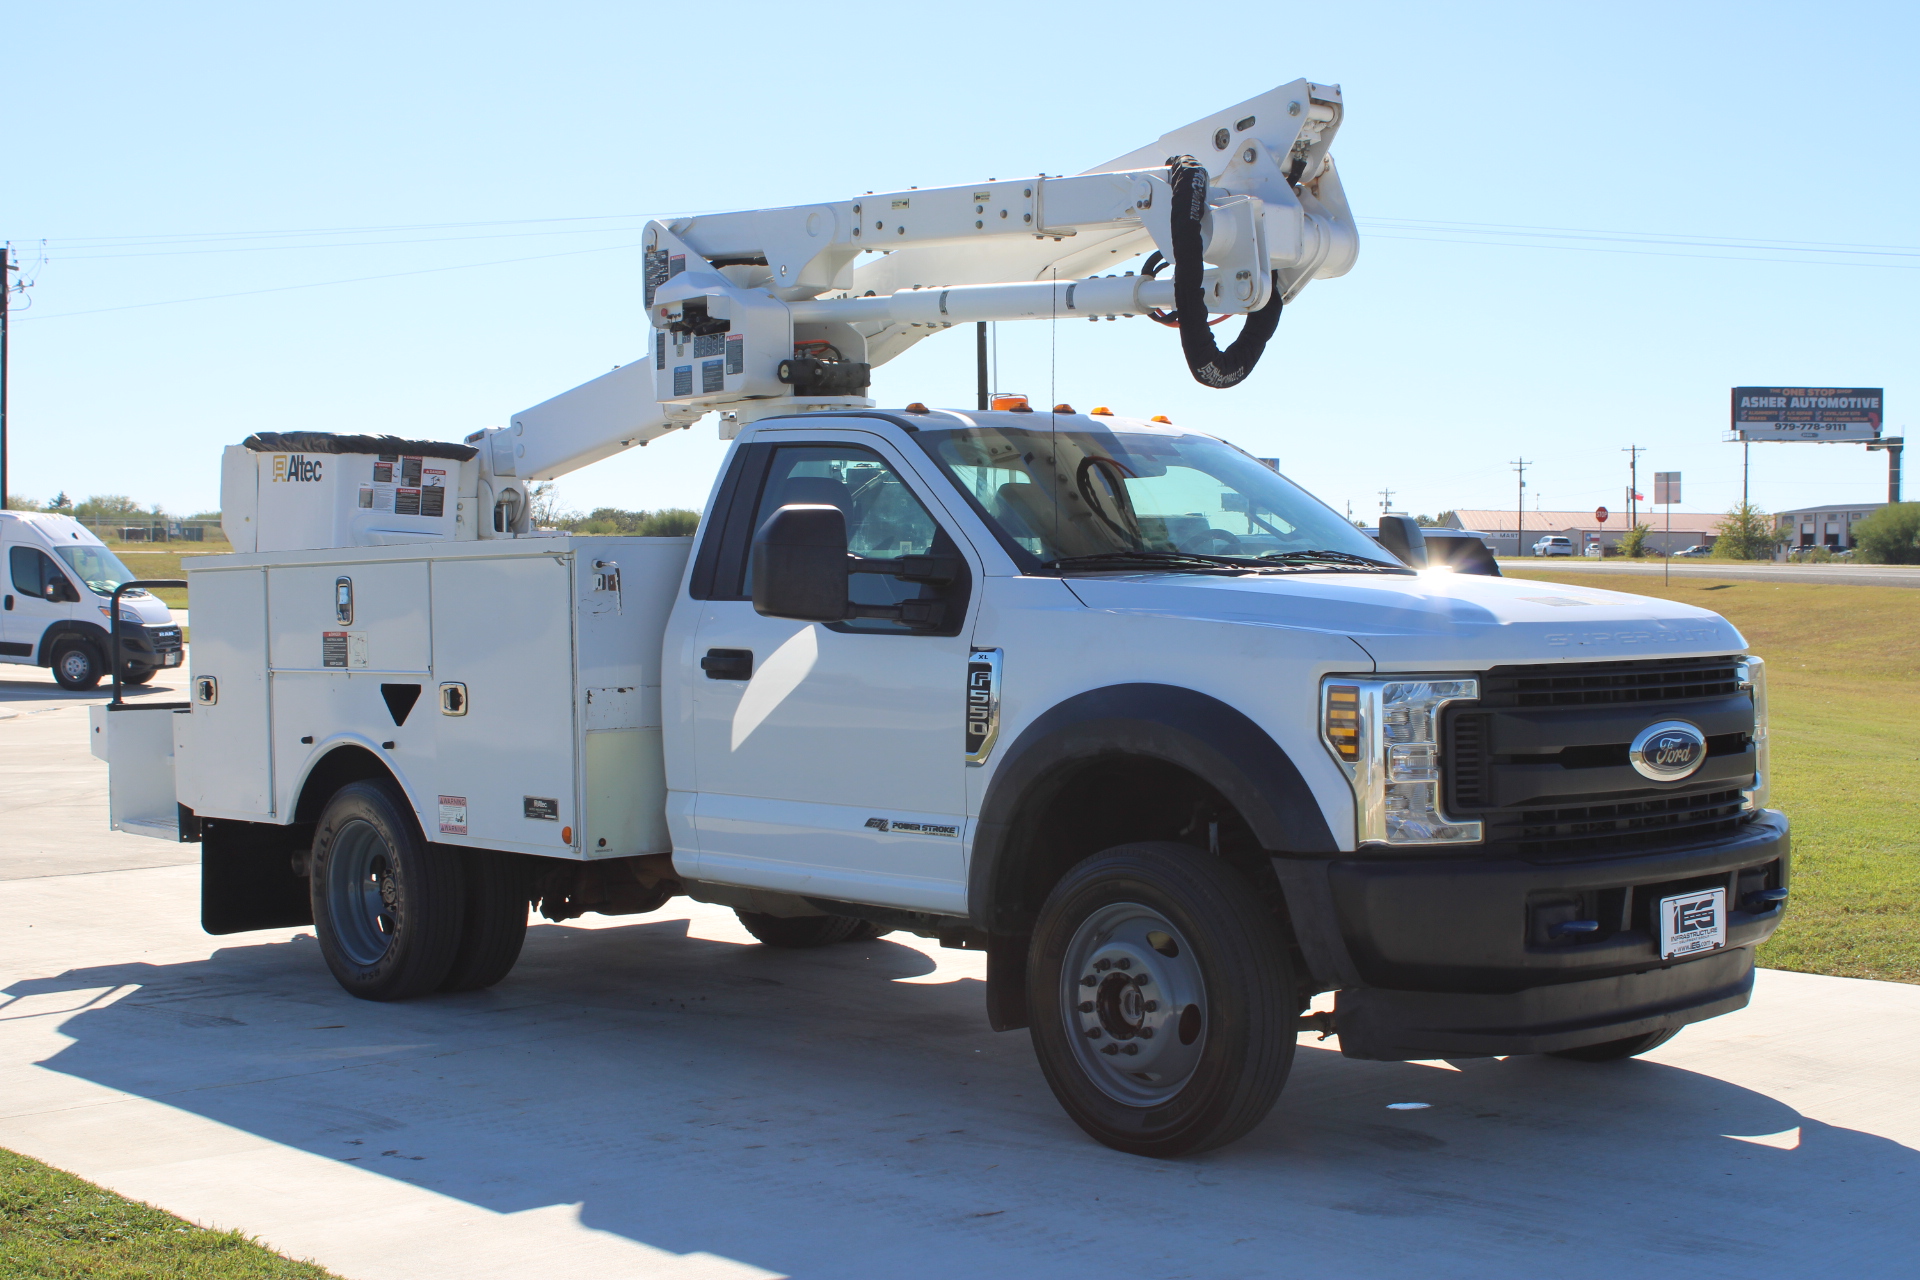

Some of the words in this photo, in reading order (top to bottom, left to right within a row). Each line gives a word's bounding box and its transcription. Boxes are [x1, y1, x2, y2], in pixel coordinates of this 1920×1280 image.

[1782, 388, 1805, 396] ONE
[1807, 388, 1836, 396] STOP
[1741, 396, 1787, 408] ASHER
[1790, 397, 1880, 409] AUTOMOTIVE
[1774, 422, 1847, 431] 979-778-9111
[287, 454, 322, 482] Altec
[1545, 631, 1658, 647] SUPER
[1657, 628, 1721, 643] DUTY
[1656, 737, 1692, 765] Ford
[443, 797, 466, 807] WARNING
[444, 825, 467, 834] WARNING
[892, 822, 920, 831] POWER
[921, 824, 956, 834] STROKE
[1671, 927, 1717, 942] INFRASTRUCTURE
